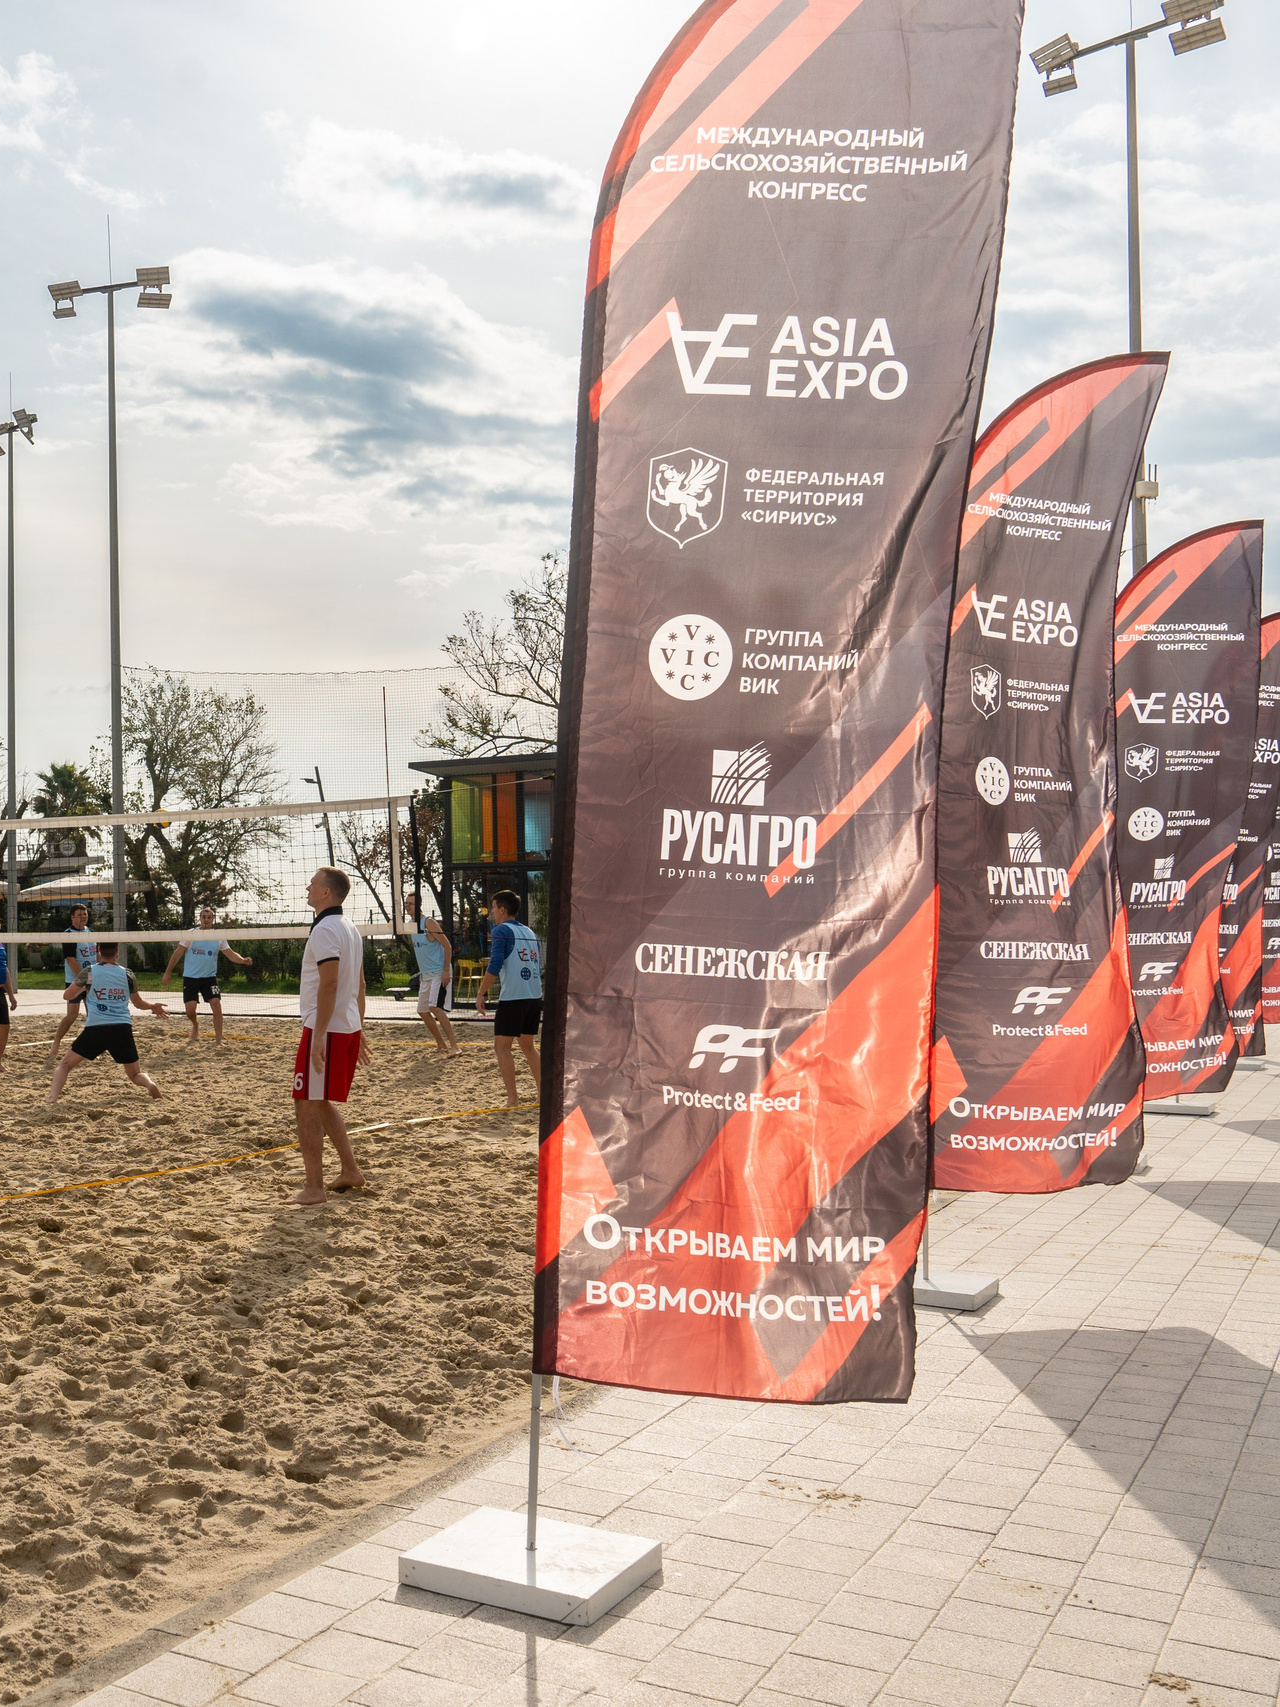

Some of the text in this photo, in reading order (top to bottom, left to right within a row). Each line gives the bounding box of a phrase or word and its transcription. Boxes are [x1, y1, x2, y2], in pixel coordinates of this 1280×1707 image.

[696, 126, 925, 150] МЕЖДУНАРОДНЫЙ
[650, 149, 968, 175] СЕЛЬСКОХОЗЯЙСТВЕННЫЙ
[747, 181, 868, 202] КОНГРЕСС
[770, 315, 895, 357] ASIA
[766, 359, 909, 401] EXPO
[745, 467, 885, 486] ФЕДЕРАЛЬНАЯ
[743, 488, 864, 506] ТЕРРИТОРИЯ
[989, 491, 1091, 515] МЕЖДУНАРОДНЫЙ
[741, 509, 837, 526] «СИРИУС»
[968, 503, 1112, 532] СЕЛЬСКОХОЗЯЙСТВЕННЫЙ
[1006, 525, 1062, 541] КОНГРЕСС
[1012, 598, 1072, 624] ASIA
[1011, 620, 1078, 647] EXPO
[1116, 632, 1245, 642] СЕЛЬСКОХОЗЯЙСТВЕННЫЙ
[1134, 623, 1228, 632] МЕЖДУНАРОДНЫЙ
[744, 628, 824, 647] ГРУППА
[1157, 643, 1208, 651] КОНГРЕСС
[741, 649, 859, 671] КОМПАНИЙ
[739, 676, 780, 695] ВИК
[1006, 678, 1070, 692] ФЕДЕРАЛЬНАЯ
[1006, 689, 1061, 702] ТЕРРИТОРИЯ
[1172, 692, 1225, 708] ASIA
[1006, 701, 1049, 712] «СИРИУС»
[1171, 708, 1230, 725] EXPO
[1013, 765, 1053, 778] ГРУППА
[1013, 779, 1073, 792] КОМПАНИЙ
[1014, 792, 1036, 803] ВИК
[1166, 818, 1211, 827] КОМПАНИЙ
[1167, 809, 1196, 818] ГРУППА
[660, 808, 817, 869] РУСАГРО
[1166, 829, 1182, 837] ВИК
[659, 866, 815, 884] группа компаний
[986, 865, 1070, 898] РУСАГРО
[1129, 879, 1187, 903] РУСАГРО
[979, 940, 1091, 961] СЕНЕЖСКАЯ
[635, 942, 830, 982] СЕНЕЖСКАЯ
[992, 1023, 1088, 1037] Protect&Feed
[294, 1072, 304, 1091] 6
[662, 1085, 801, 1112] Protect&Feed
